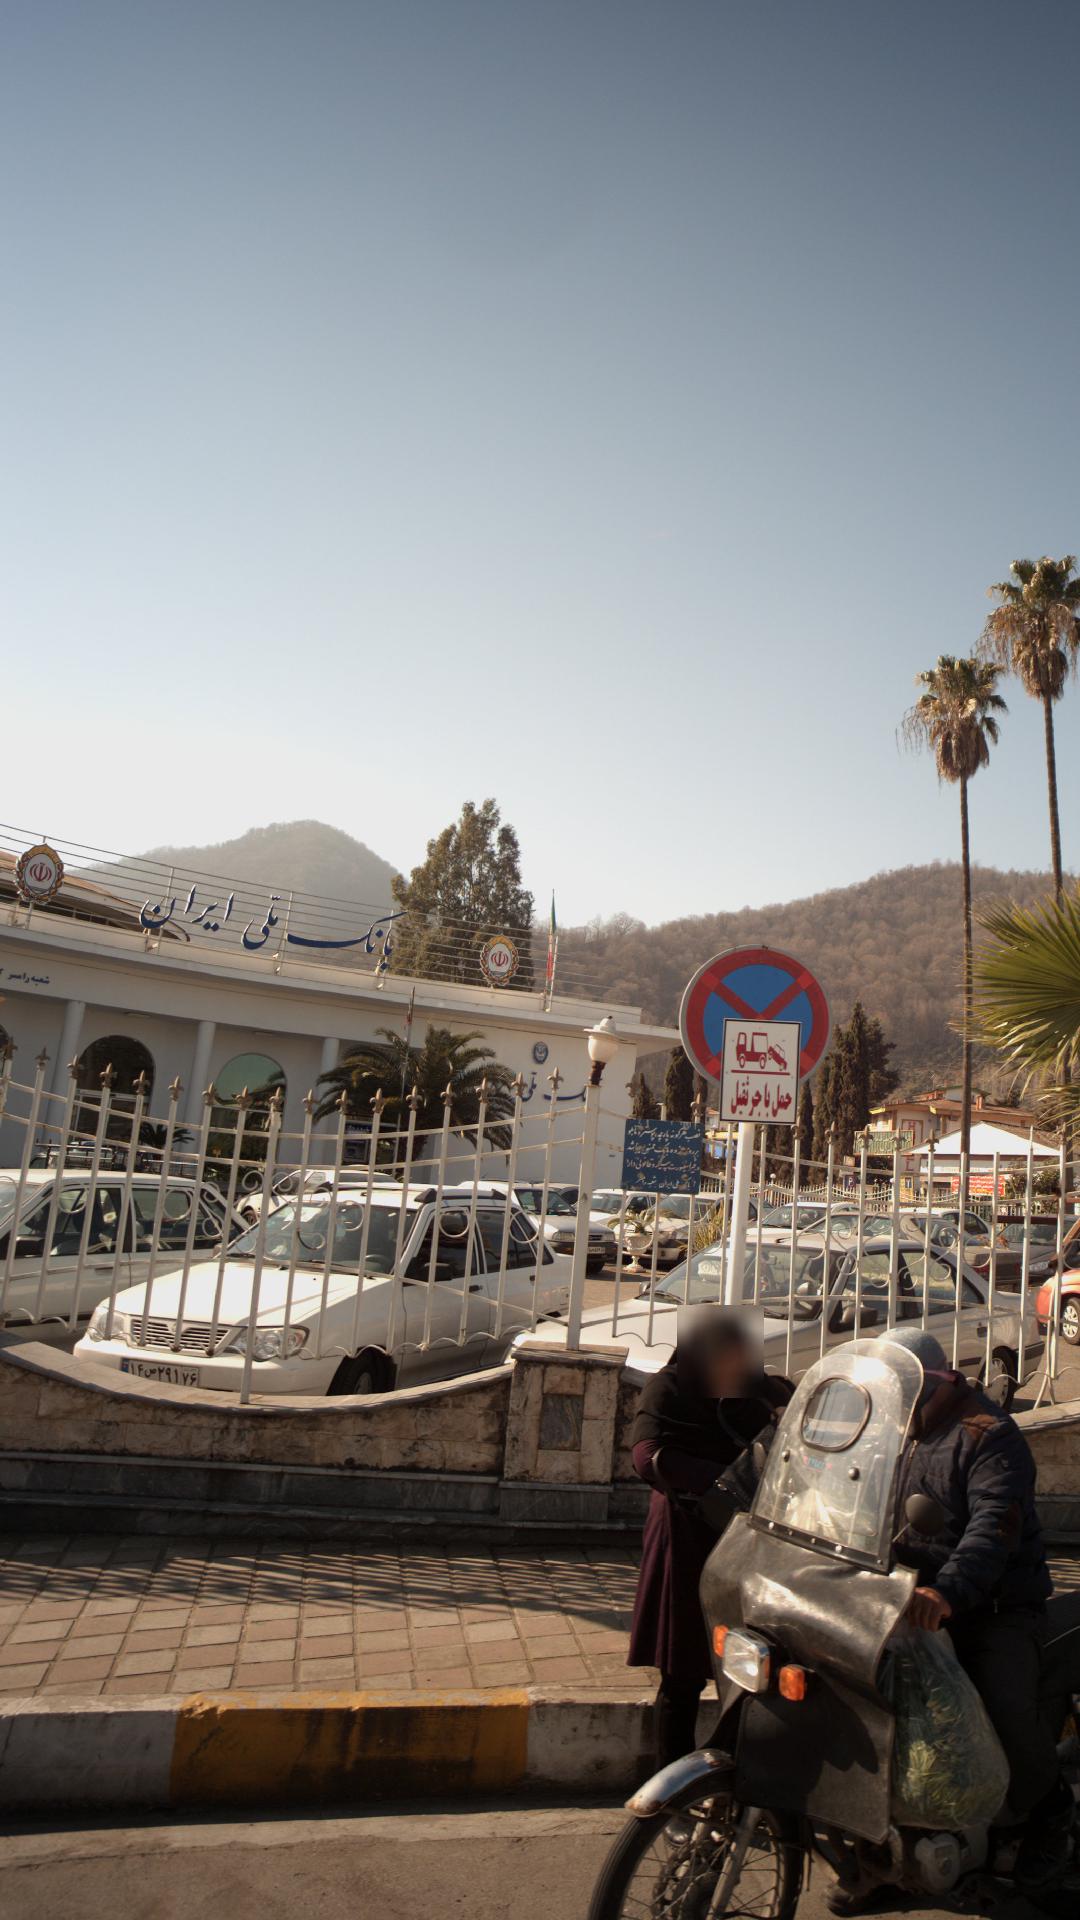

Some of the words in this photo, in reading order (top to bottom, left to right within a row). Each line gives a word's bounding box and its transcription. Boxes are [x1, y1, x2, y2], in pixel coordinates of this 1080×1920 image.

[139, 884, 235, 929] ایران
[287, 911, 407, 971] بانک
[31, 976, 50, 986] شعبه
[764, 1082, 771, 1117] با
[772, 1083, 792, 1117] حمل
